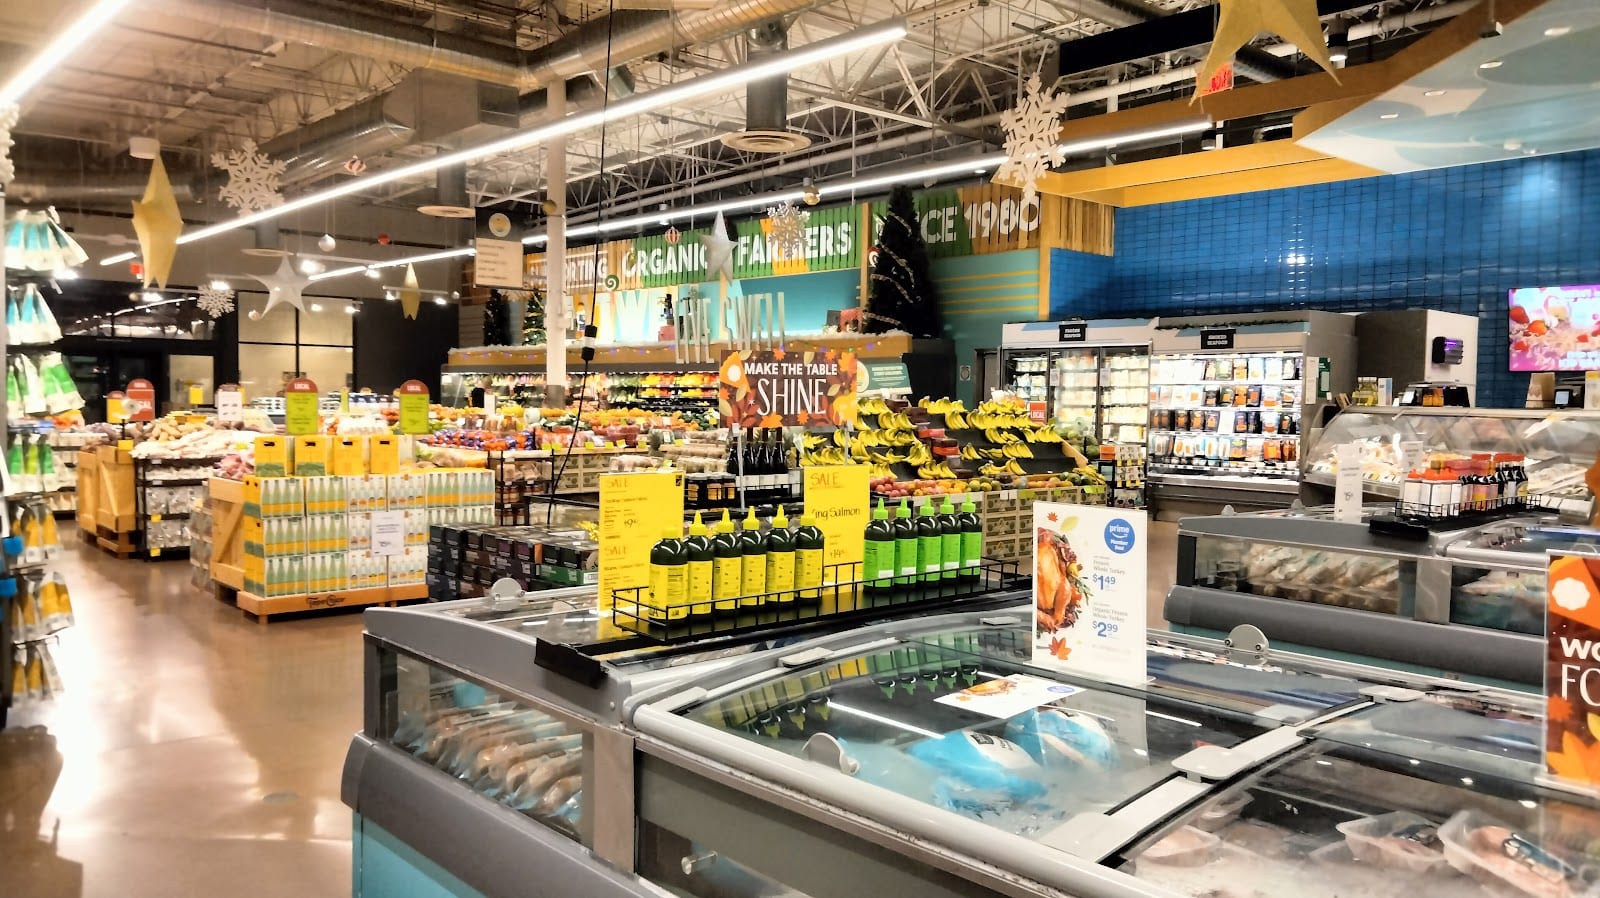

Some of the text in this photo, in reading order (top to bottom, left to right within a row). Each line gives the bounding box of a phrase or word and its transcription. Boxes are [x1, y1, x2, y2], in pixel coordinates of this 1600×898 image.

[964, 195, 1042, 239] 1980
[744, 362, 838, 376] MAKE THE TABLE
[757, 378, 827, 417] SHINE
[1030, 411, 1045, 419] LOCAL
[810, 472, 841, 486] SALE
[829, 506, 861, 517] Salmon
[1109, 524, 1130, 534] prime
